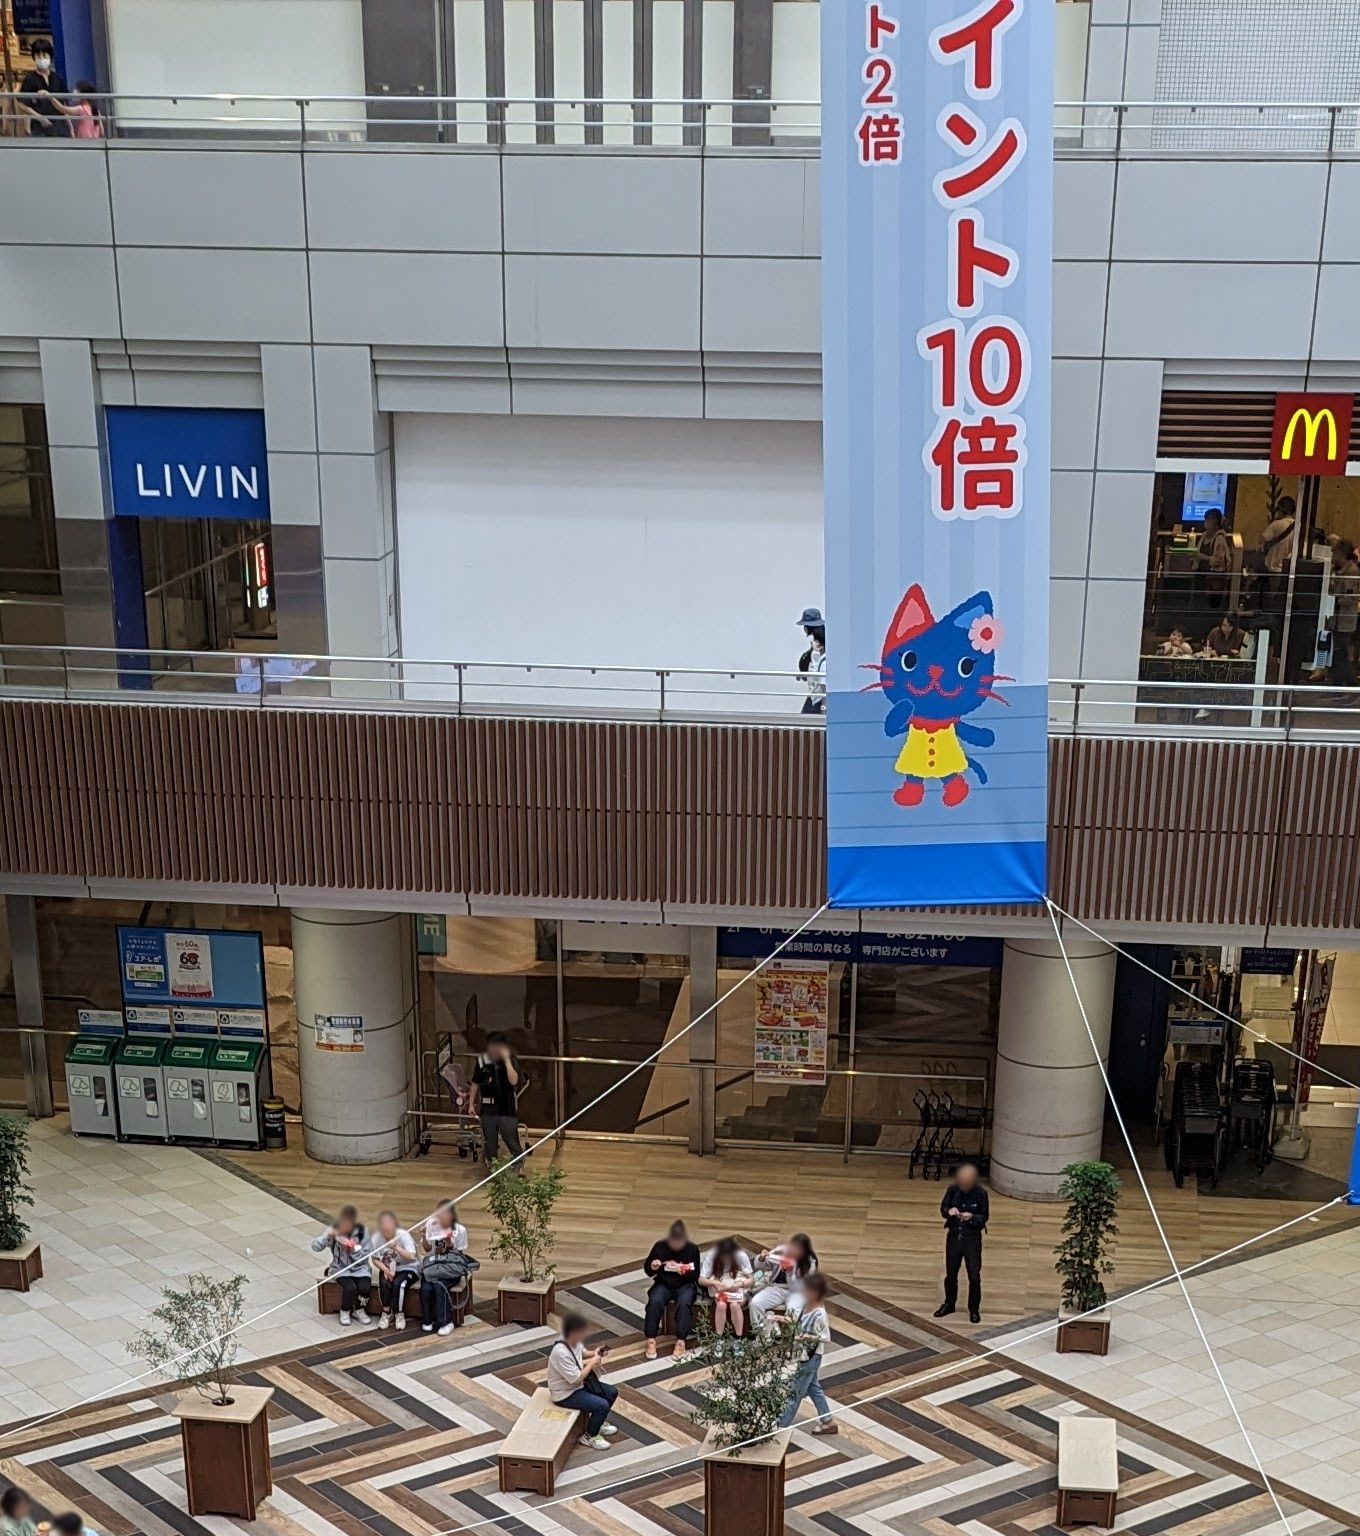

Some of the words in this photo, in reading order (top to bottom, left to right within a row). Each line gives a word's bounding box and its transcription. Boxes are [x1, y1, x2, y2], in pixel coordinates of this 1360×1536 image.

[858, 5, 901, 162] ト2倍
[926, 0, 1022, 511] イント10倍
[136, 463, 259, 500] LIVIN
[861, 944, 950, 960] 専門店がございます
